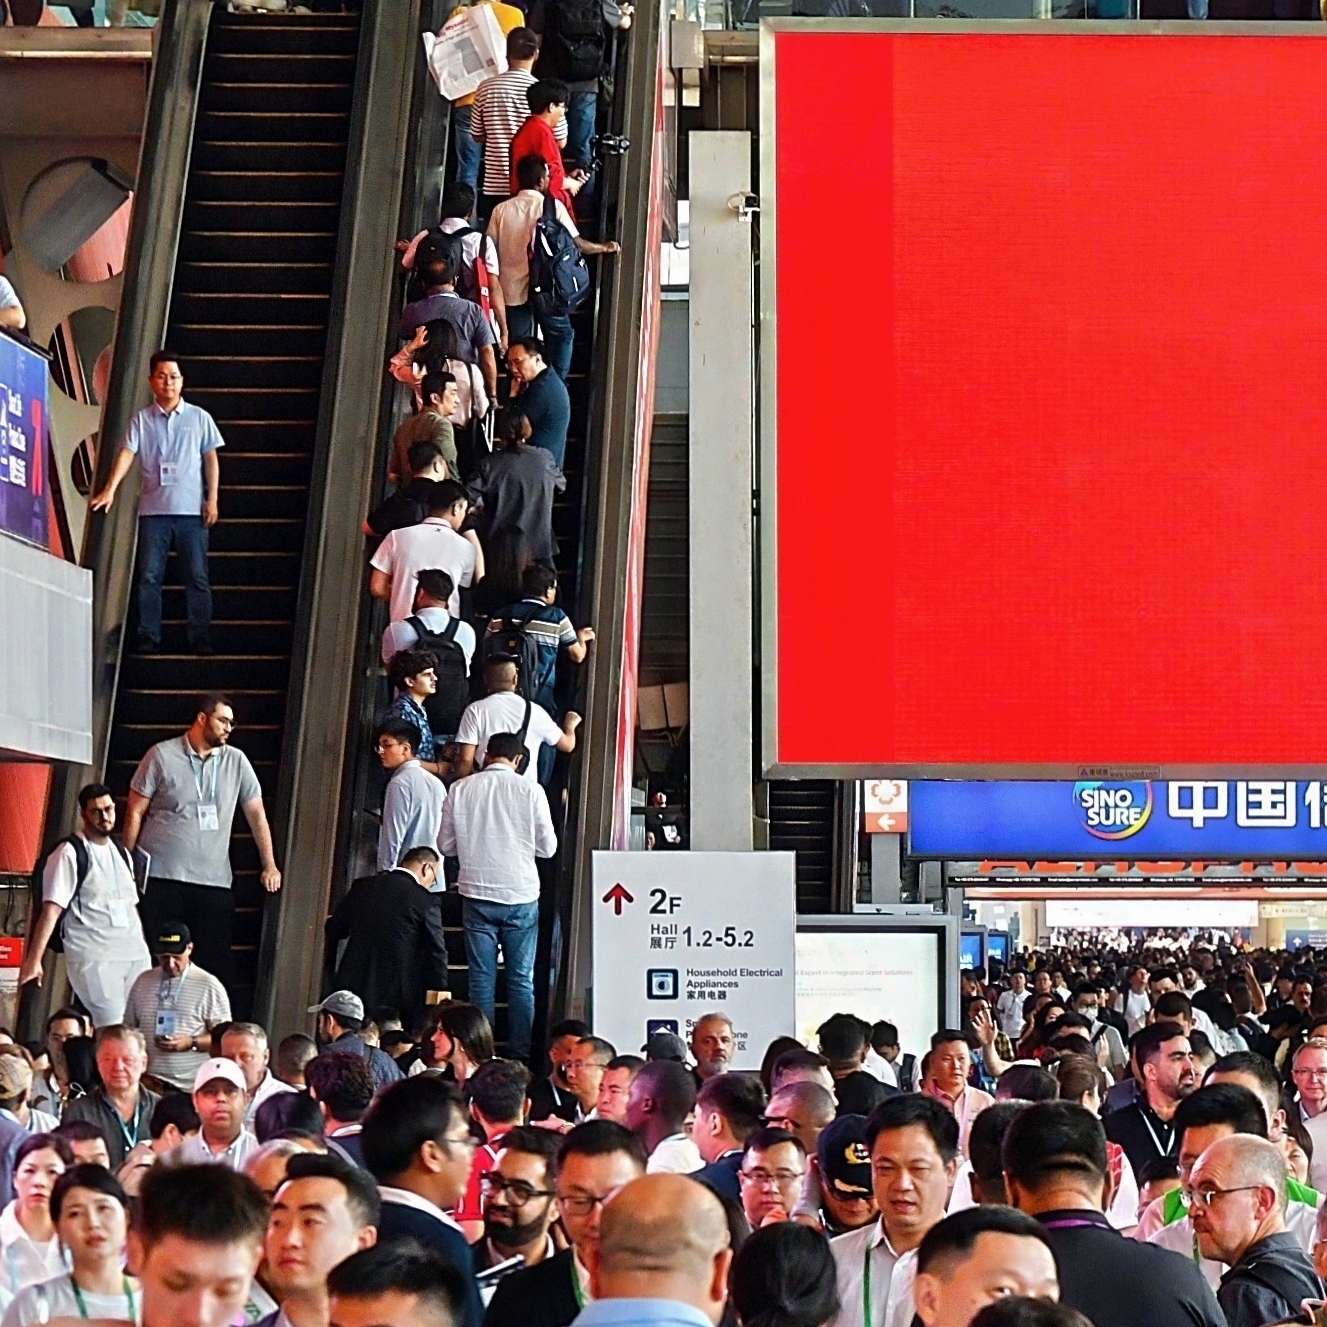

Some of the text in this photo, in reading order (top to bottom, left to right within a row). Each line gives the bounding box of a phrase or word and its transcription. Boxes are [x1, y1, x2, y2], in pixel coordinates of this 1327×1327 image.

[1080, 789, 1133, 808] SINO
[1087, 807, 1142, 826] SURE
[648, 887, 682, 915] 2F
[650, 924, 678, 936] Hall
[682, 926, 754, 948] 1.2-5.2
[649, 937, 677, 950] 展厅
[686, 968, 784, 978] Household Electrical
[800, 969, 822, 977] Expert
[686, 980, 740, 990] Appliances
[686, 990, 728, 1001] 家用电器
